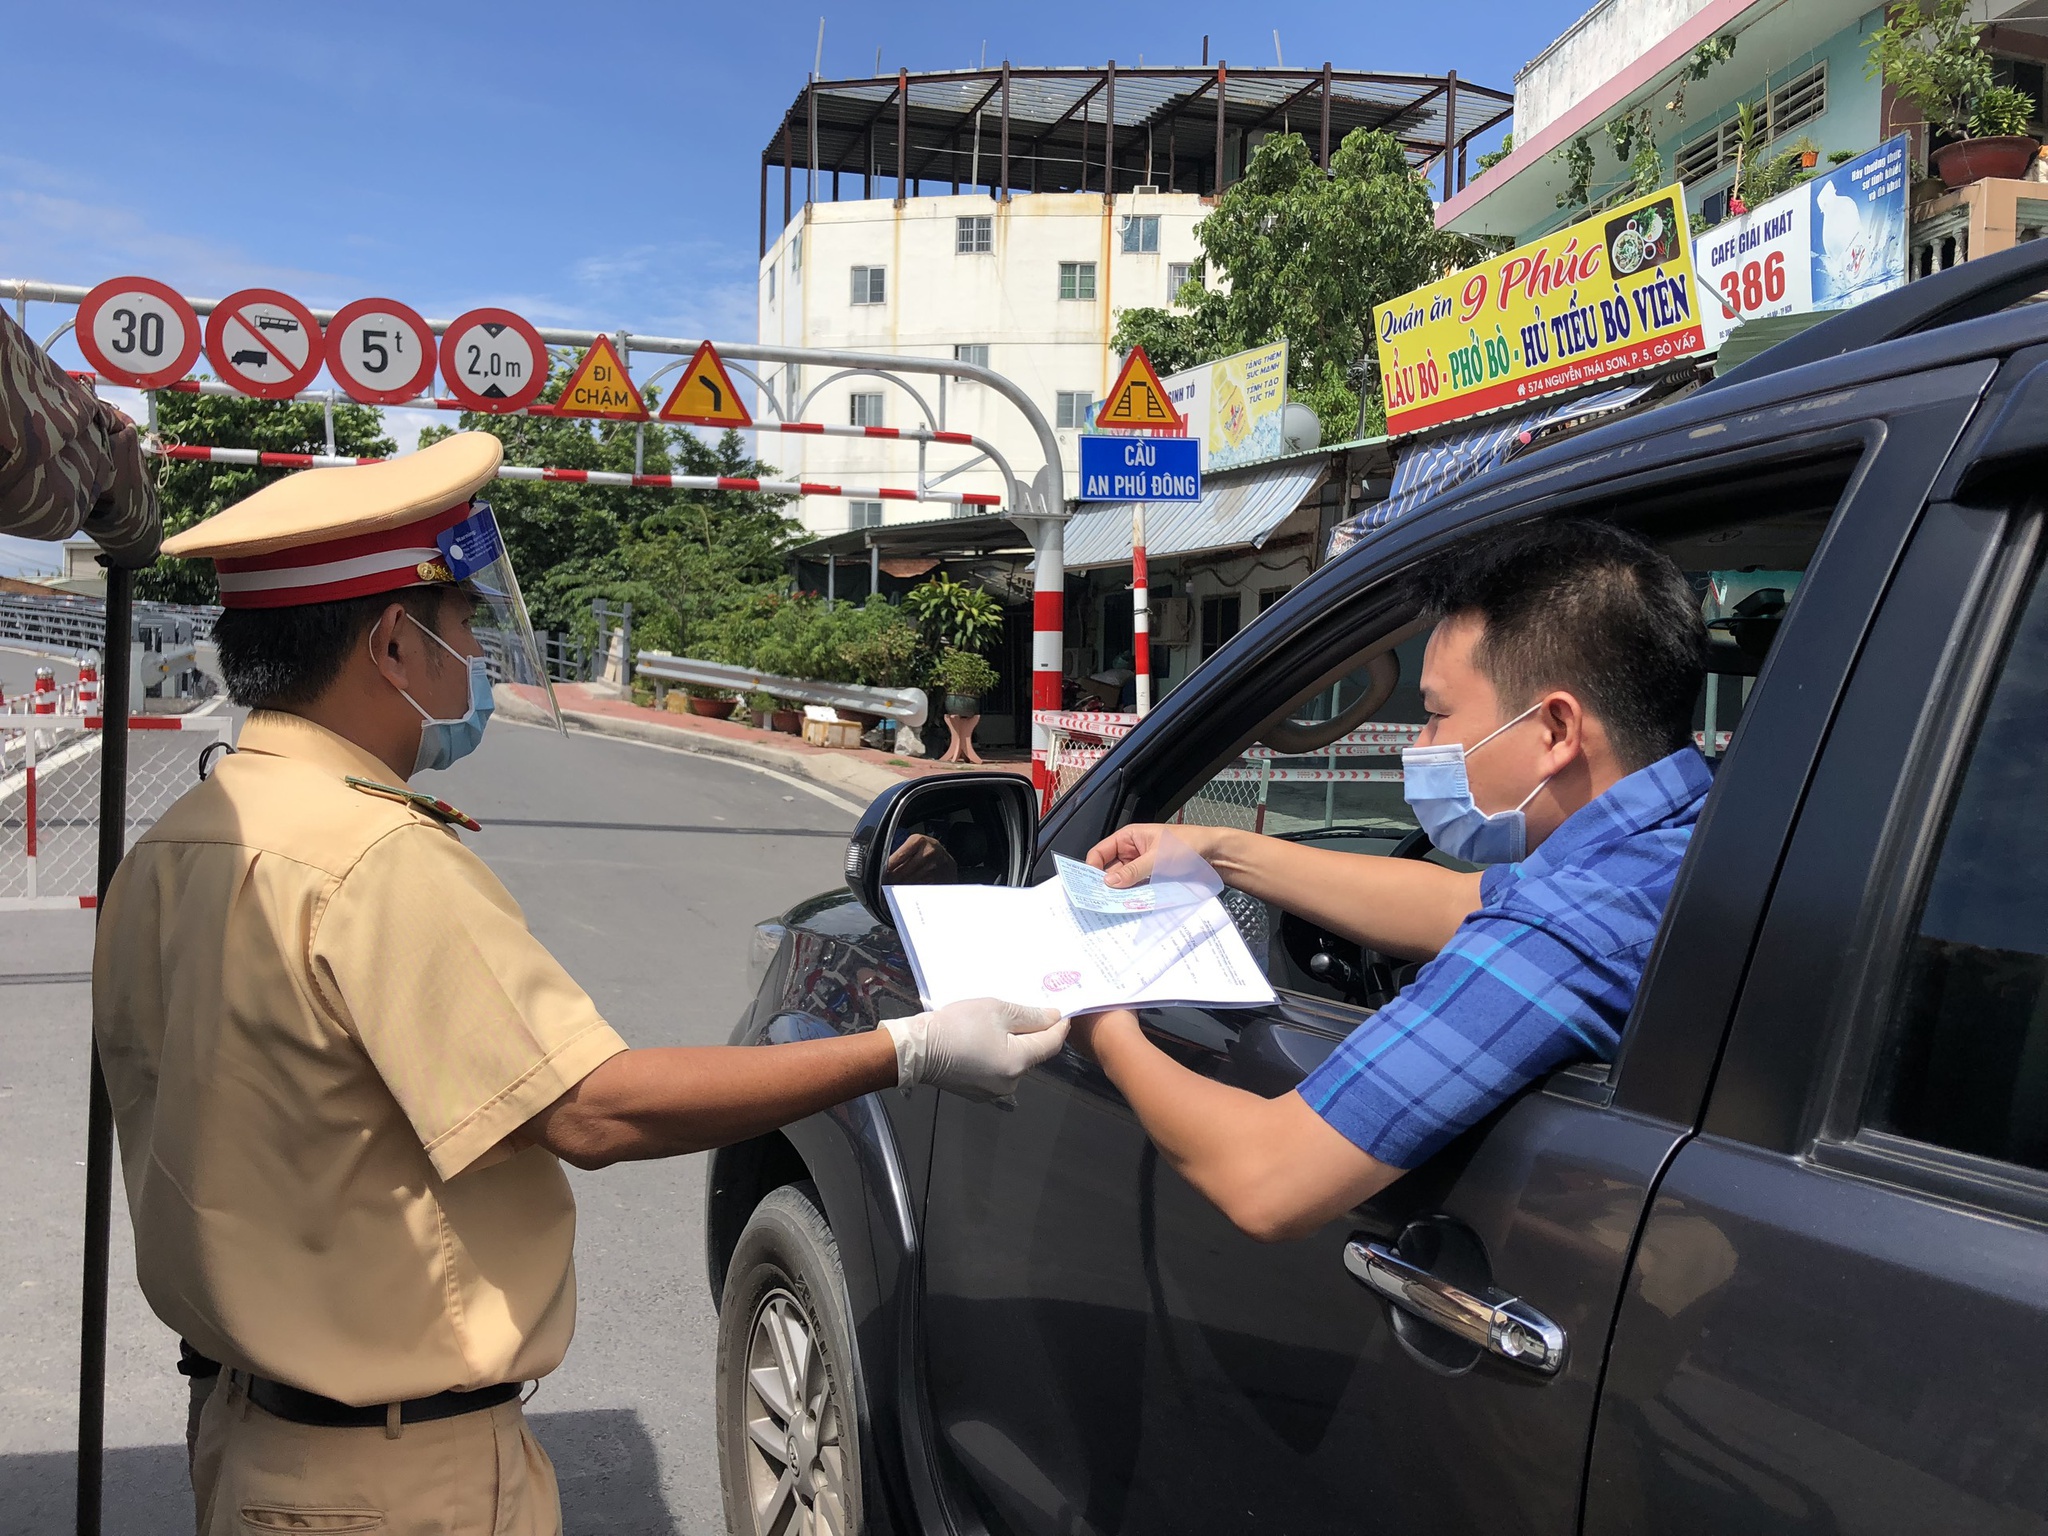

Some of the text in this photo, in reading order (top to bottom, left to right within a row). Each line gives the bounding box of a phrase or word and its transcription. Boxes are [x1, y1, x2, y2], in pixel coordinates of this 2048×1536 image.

[1711, 209, 1794, 268] CAFÉ GIẢI KHÁT
[1380, 238, 1603, 343] Quán ăn 9 Phúc
[1720, 250, 1785, 320] 386
[111, 308, 165, 357] 30
[1384, 347, 1415, 409] LẨU
[1416, 348, 1439, 399] BÒ
[1448, 328, 1484, 390] PHỞ
[1484, 324, 1510, 379] BÒ
[1520, 305, 1549, 368] HỦ
[1551, 289, 1598, 358] TIẾU
[1600, 283, 1631, 343] BÒ
[1632, 267, 1691, 333] VIÊN
[592, 365, 612, 383] ĐI
[1528, 382, 1544, 393] 574
[1545, 366, 1583, 387] NGUYỄN
[1583, 361, 1604, 377] THÁI
[1606, 355, 1631, 370] SƠN,
[1642, 349, 1653, 361] 5,
[1653, 340, 1672, 357] GÒ
[1674, 332, 1697, 351] VẤP
[574, 386, 630, 409] CHẬM
[1168, 379, 1195, 404] SINH TỐ
[1124, 437, 1156, 467] CẦU
[1087, 471, 1196, 497] AN PHÚ ĐÔNG
